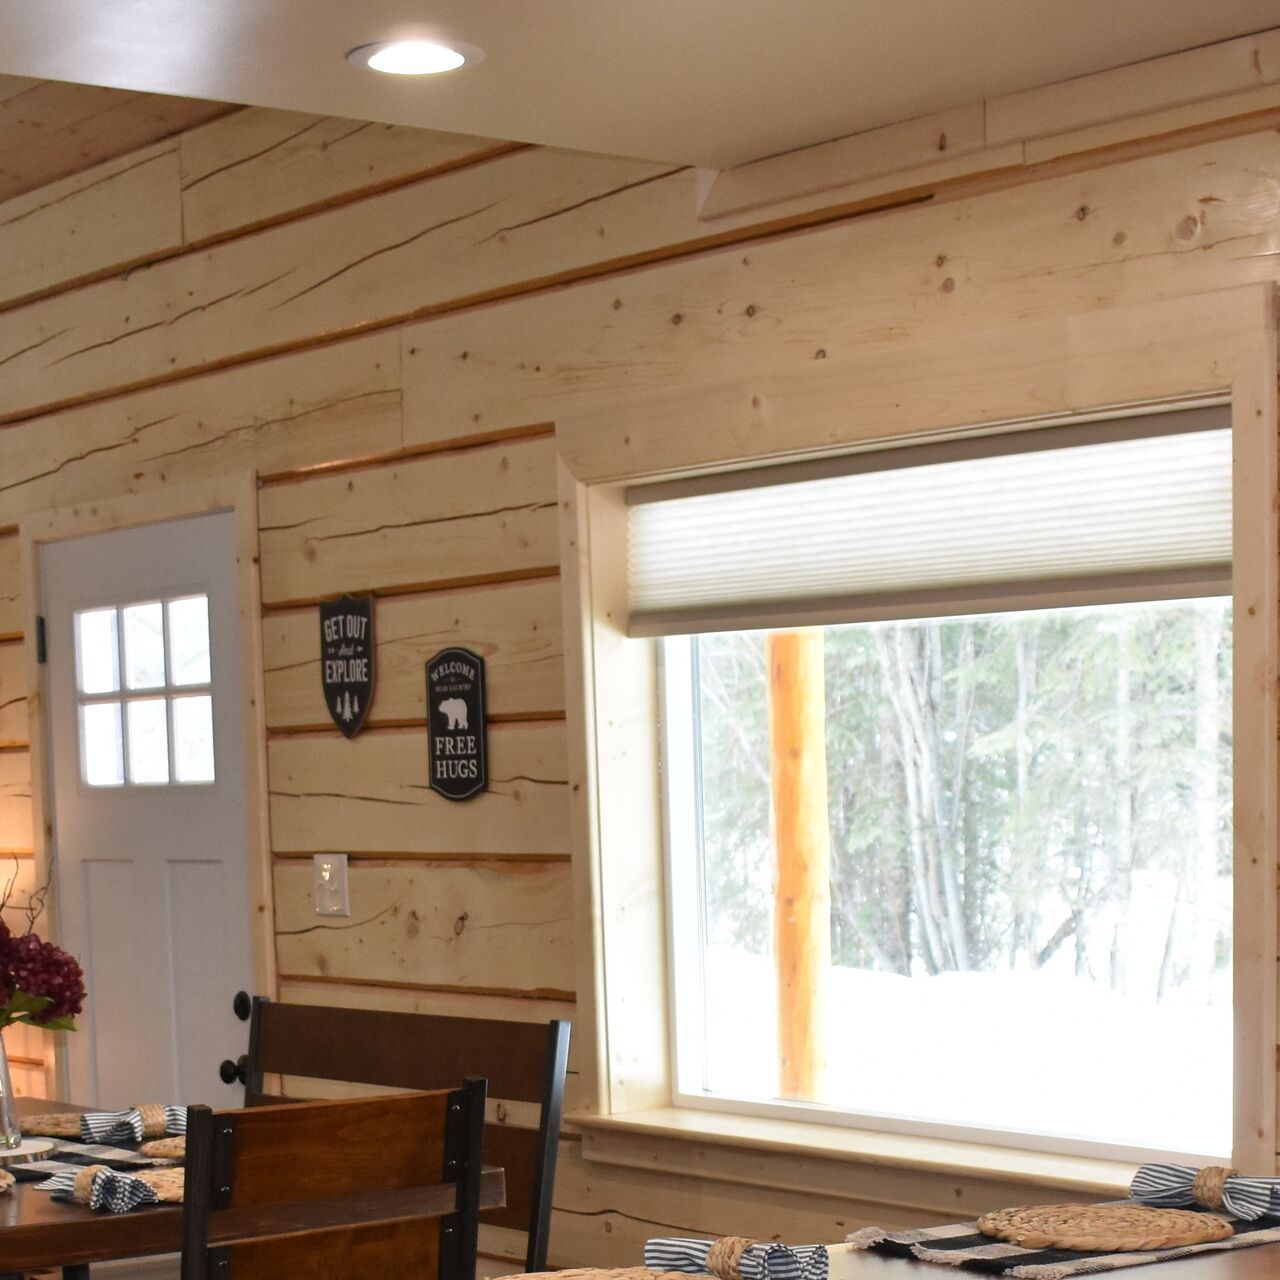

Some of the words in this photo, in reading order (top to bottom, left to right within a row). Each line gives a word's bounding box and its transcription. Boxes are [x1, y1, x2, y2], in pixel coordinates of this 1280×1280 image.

[324, 615, 344, 642] GET
[346, 614, 368, 640] OUT
[325, 658, 368, 683] EXPLORE
[430, 661, 476, 682] WELCOME
[435, 736, 477, 755] FREE
[436, 760, 477, 778] HUGS
